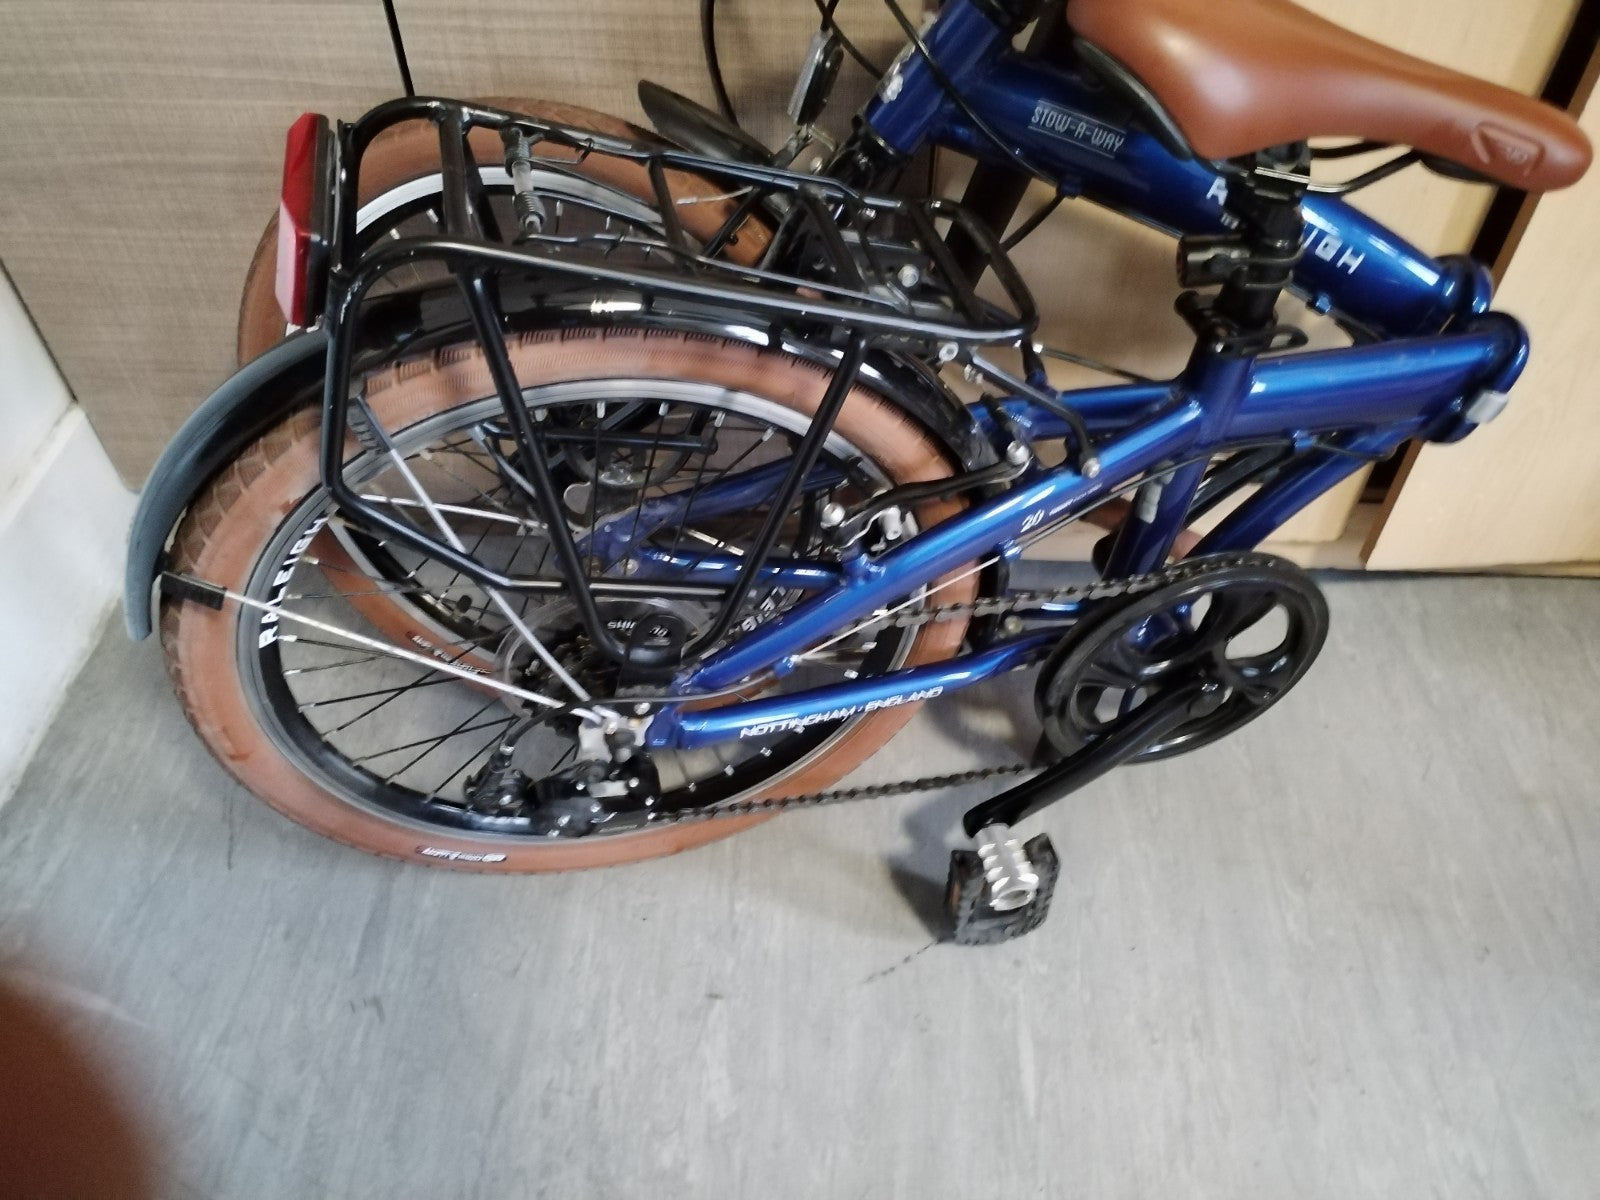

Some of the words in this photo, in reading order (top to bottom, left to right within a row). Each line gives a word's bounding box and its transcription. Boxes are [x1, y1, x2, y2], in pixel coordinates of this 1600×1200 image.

[1031, 106, 1125, 153] STOW-A-WAY
[740, 705, 856, 739] NOTTINGHAM
[865, 686, 944, 713] ENGLAND
